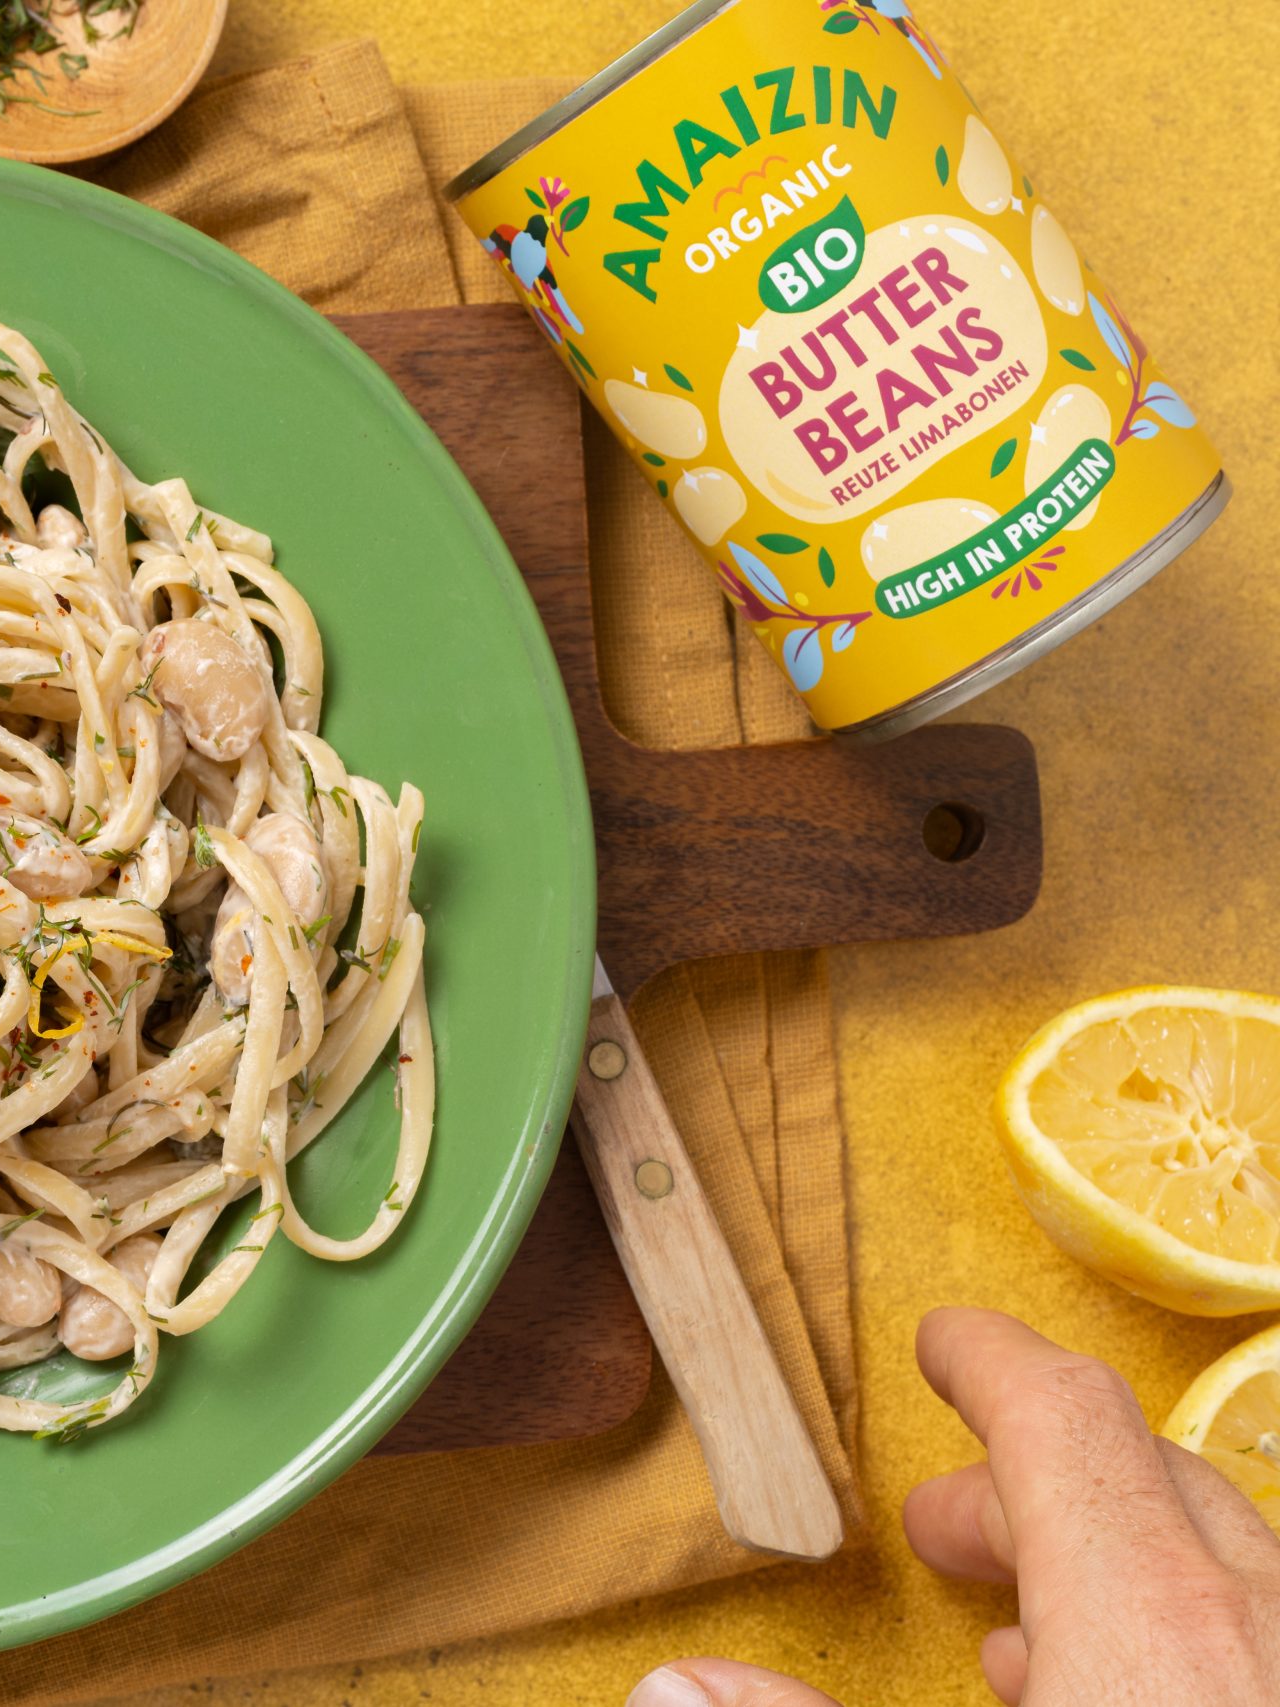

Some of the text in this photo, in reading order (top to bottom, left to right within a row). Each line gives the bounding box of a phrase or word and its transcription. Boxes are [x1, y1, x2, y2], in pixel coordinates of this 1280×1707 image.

[603, 65, 897, 303] AMAIZIN
[684, 144, 852, 274] ORGANIC
[767, 226, 858, 307] BIO
[749, 247, 968, 420] BUTTER
[792, 307, 1004, 475] BEANS
[829, 359, 1030, 507] REUZE LIMABONEN
[884, 447, 1111, 615] HIGH IN PROTEIN
